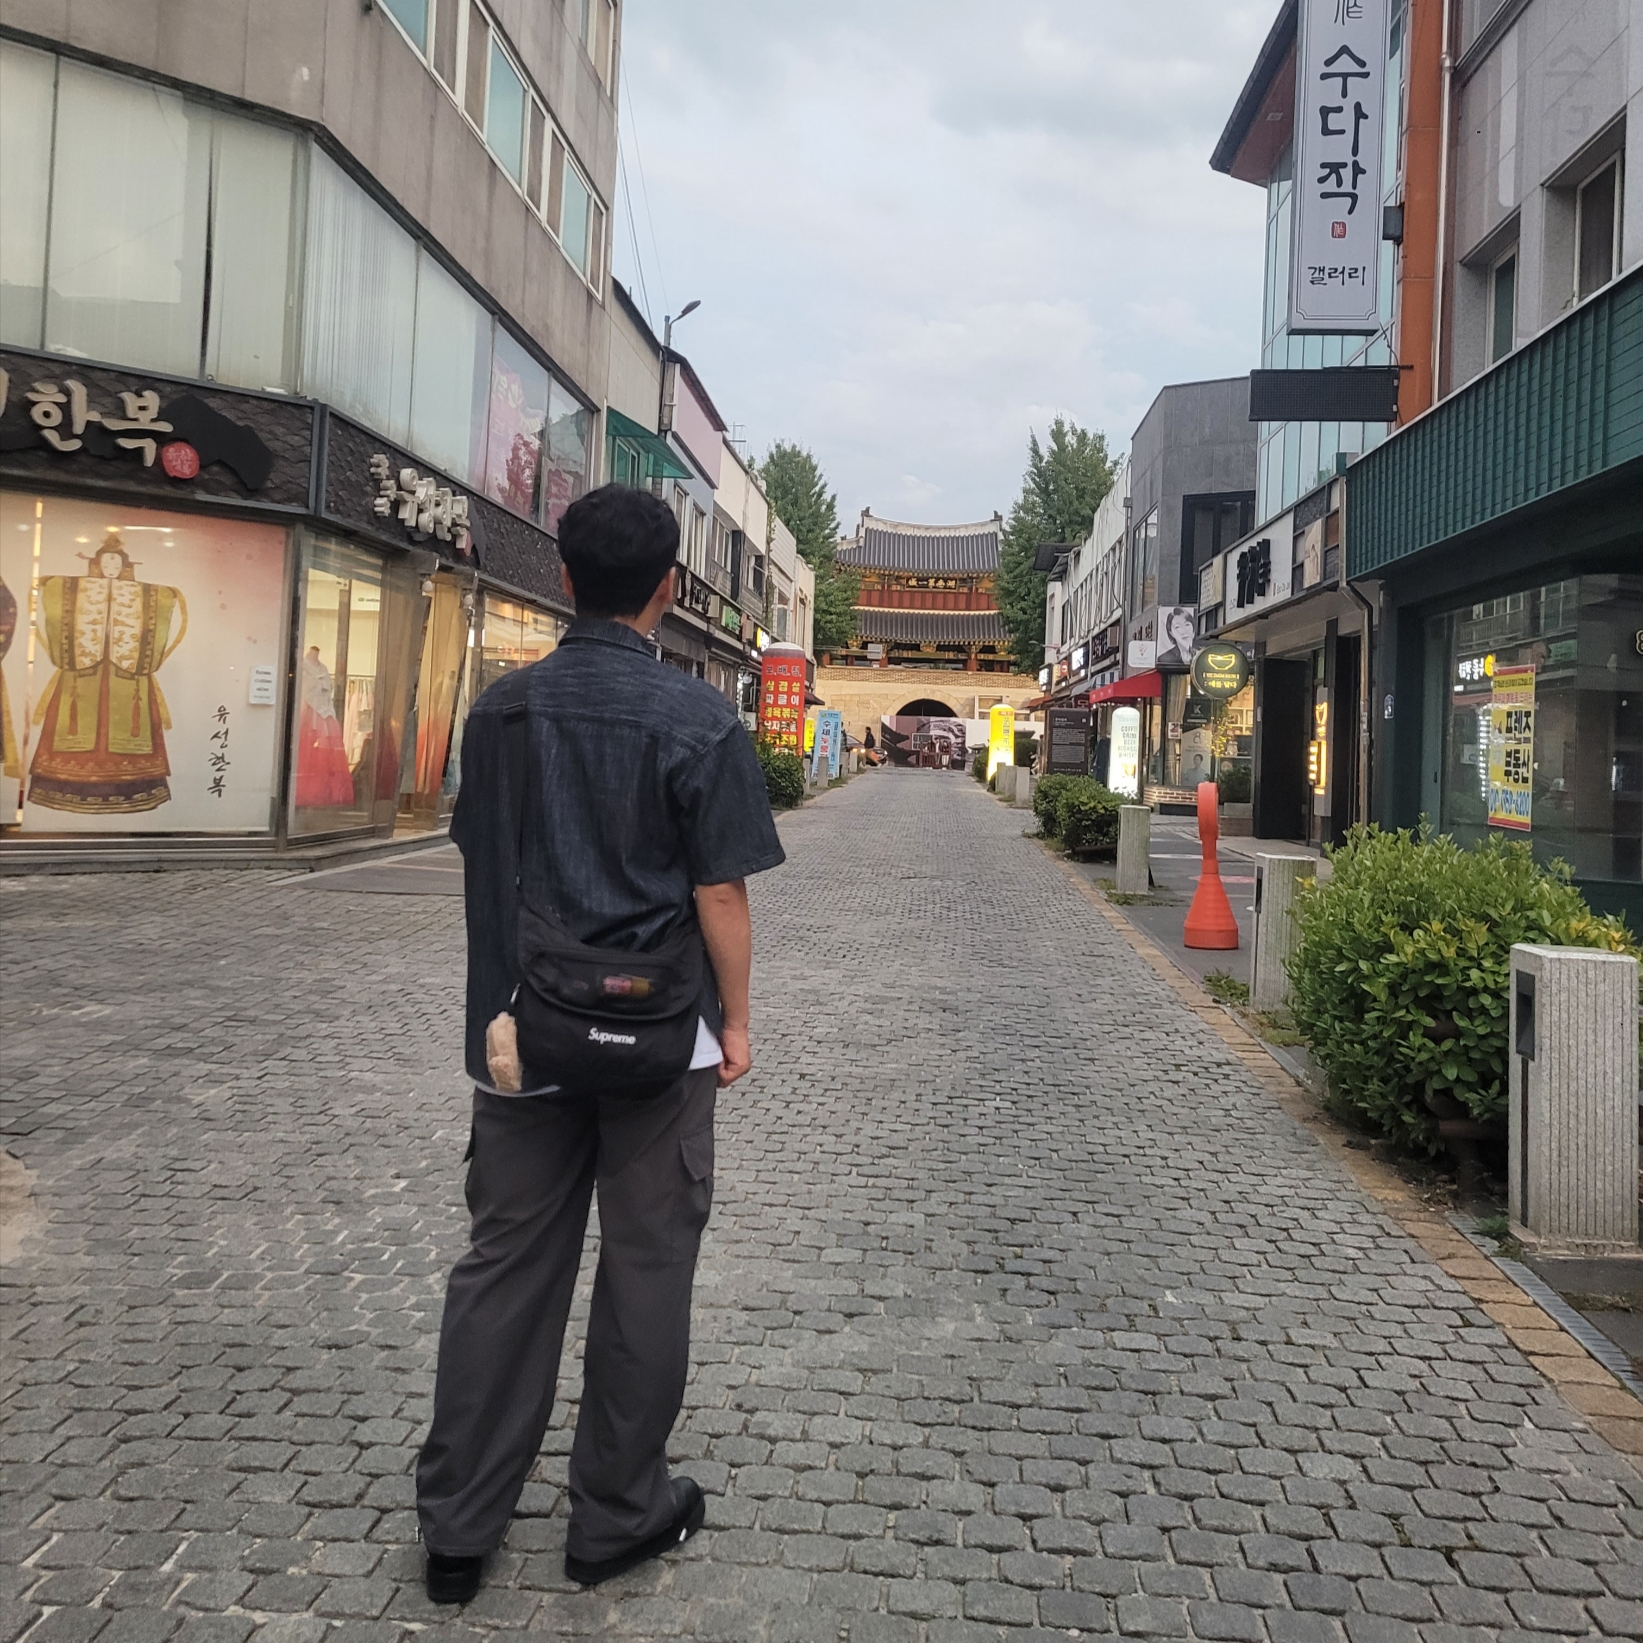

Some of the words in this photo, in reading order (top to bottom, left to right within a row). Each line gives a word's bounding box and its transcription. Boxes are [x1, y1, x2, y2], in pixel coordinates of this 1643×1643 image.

[1317, 44, 1371, 216] 수다작
[1307, 265, 1367, 287] 갤러리
[1504, 748, 1530, 784] 부동산
[588, 1027, 636, 1045] Supreme
